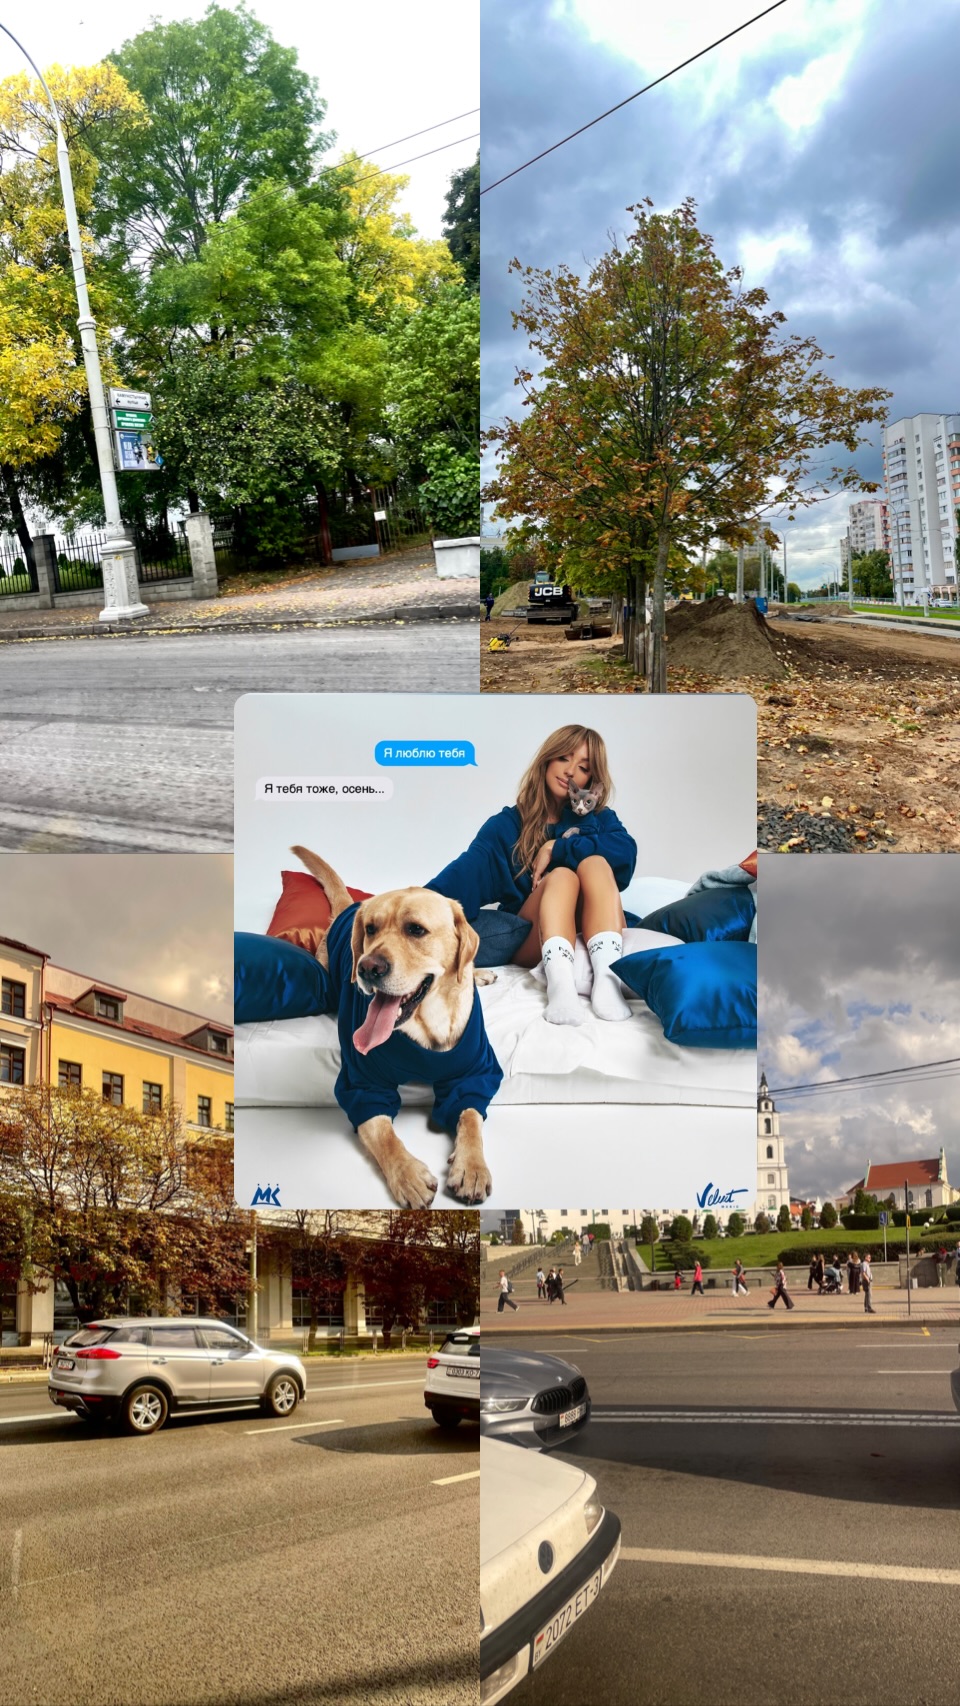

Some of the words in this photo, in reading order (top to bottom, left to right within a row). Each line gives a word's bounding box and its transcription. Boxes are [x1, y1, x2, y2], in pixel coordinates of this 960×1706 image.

[535, 587, 563, 596] JCB
[545, 1604, 572, 1650] 2072
[575, 1575, 599, 1617] ET-3
